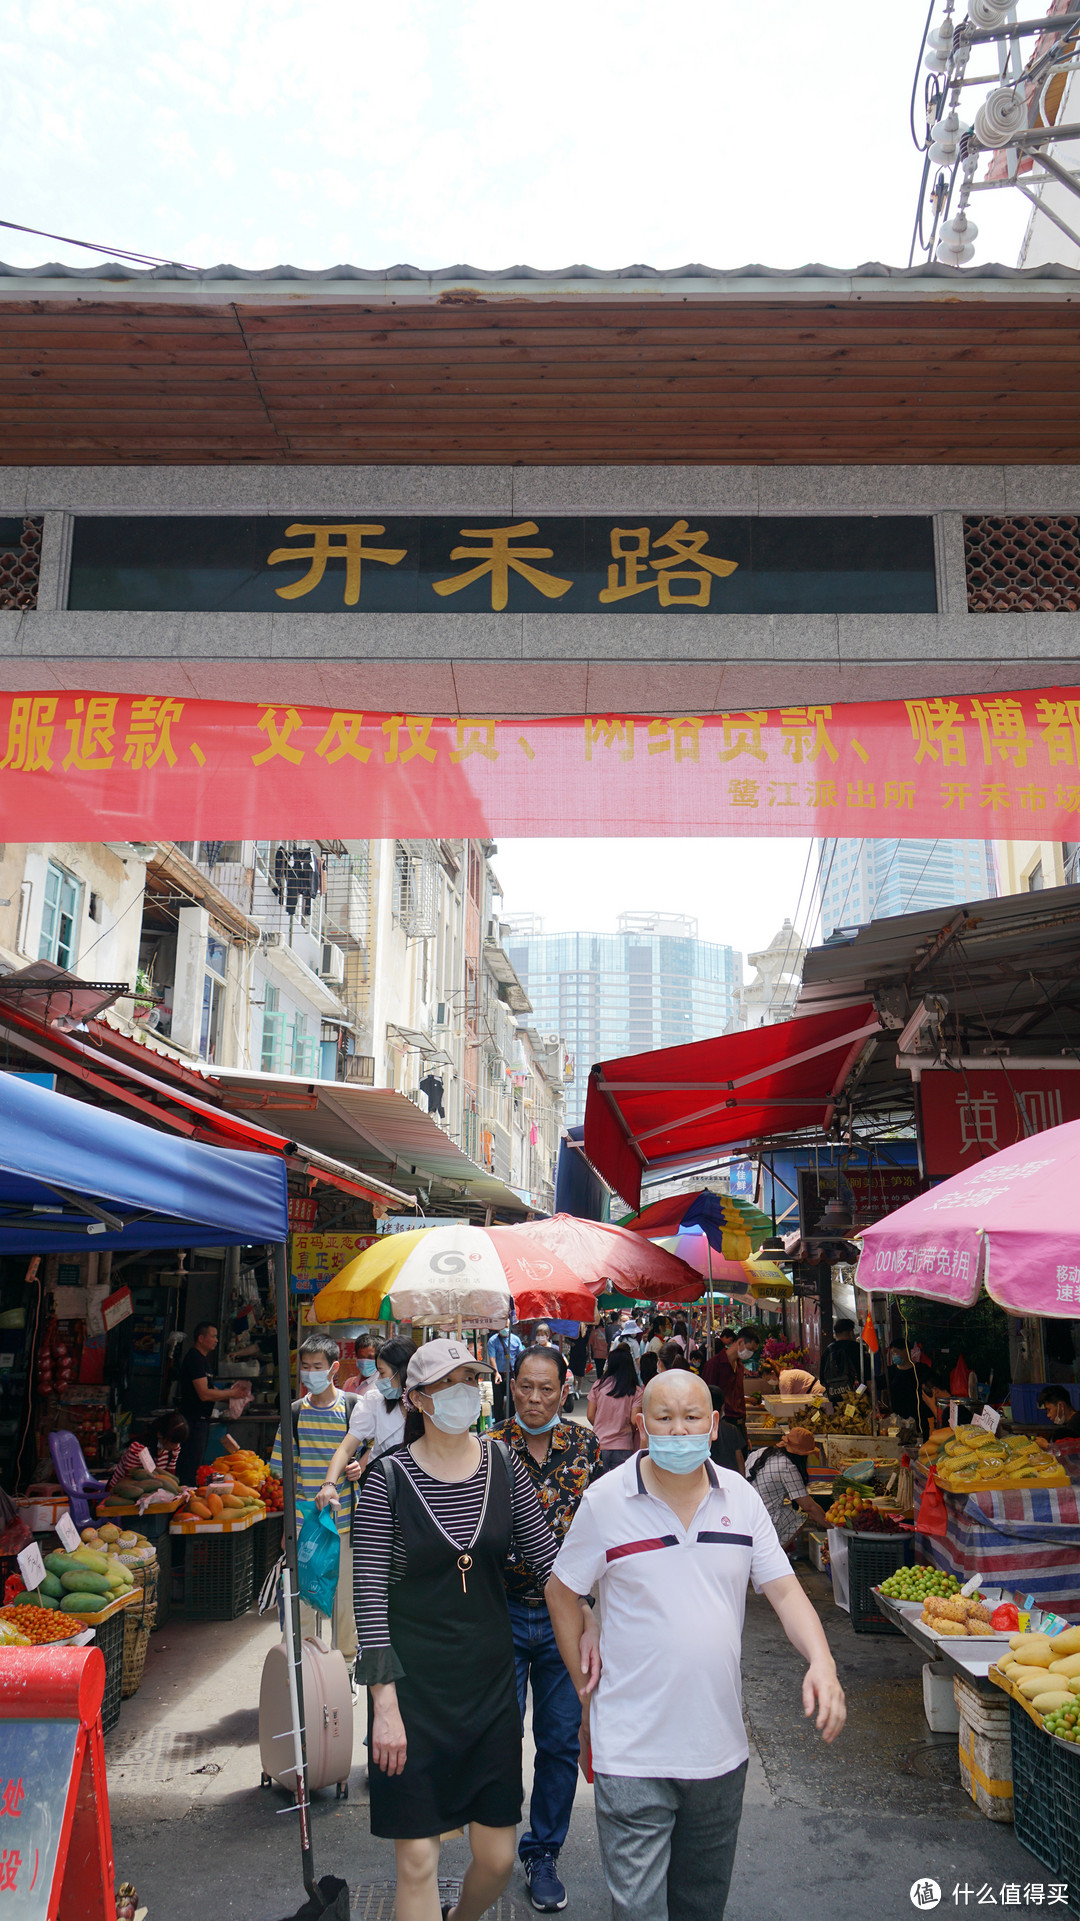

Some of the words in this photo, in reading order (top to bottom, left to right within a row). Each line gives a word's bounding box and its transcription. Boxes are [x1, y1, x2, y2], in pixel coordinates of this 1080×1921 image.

[267, 520, 738, 611] 开禾路
[728, 778, 916, 809] 鹭江派出所
